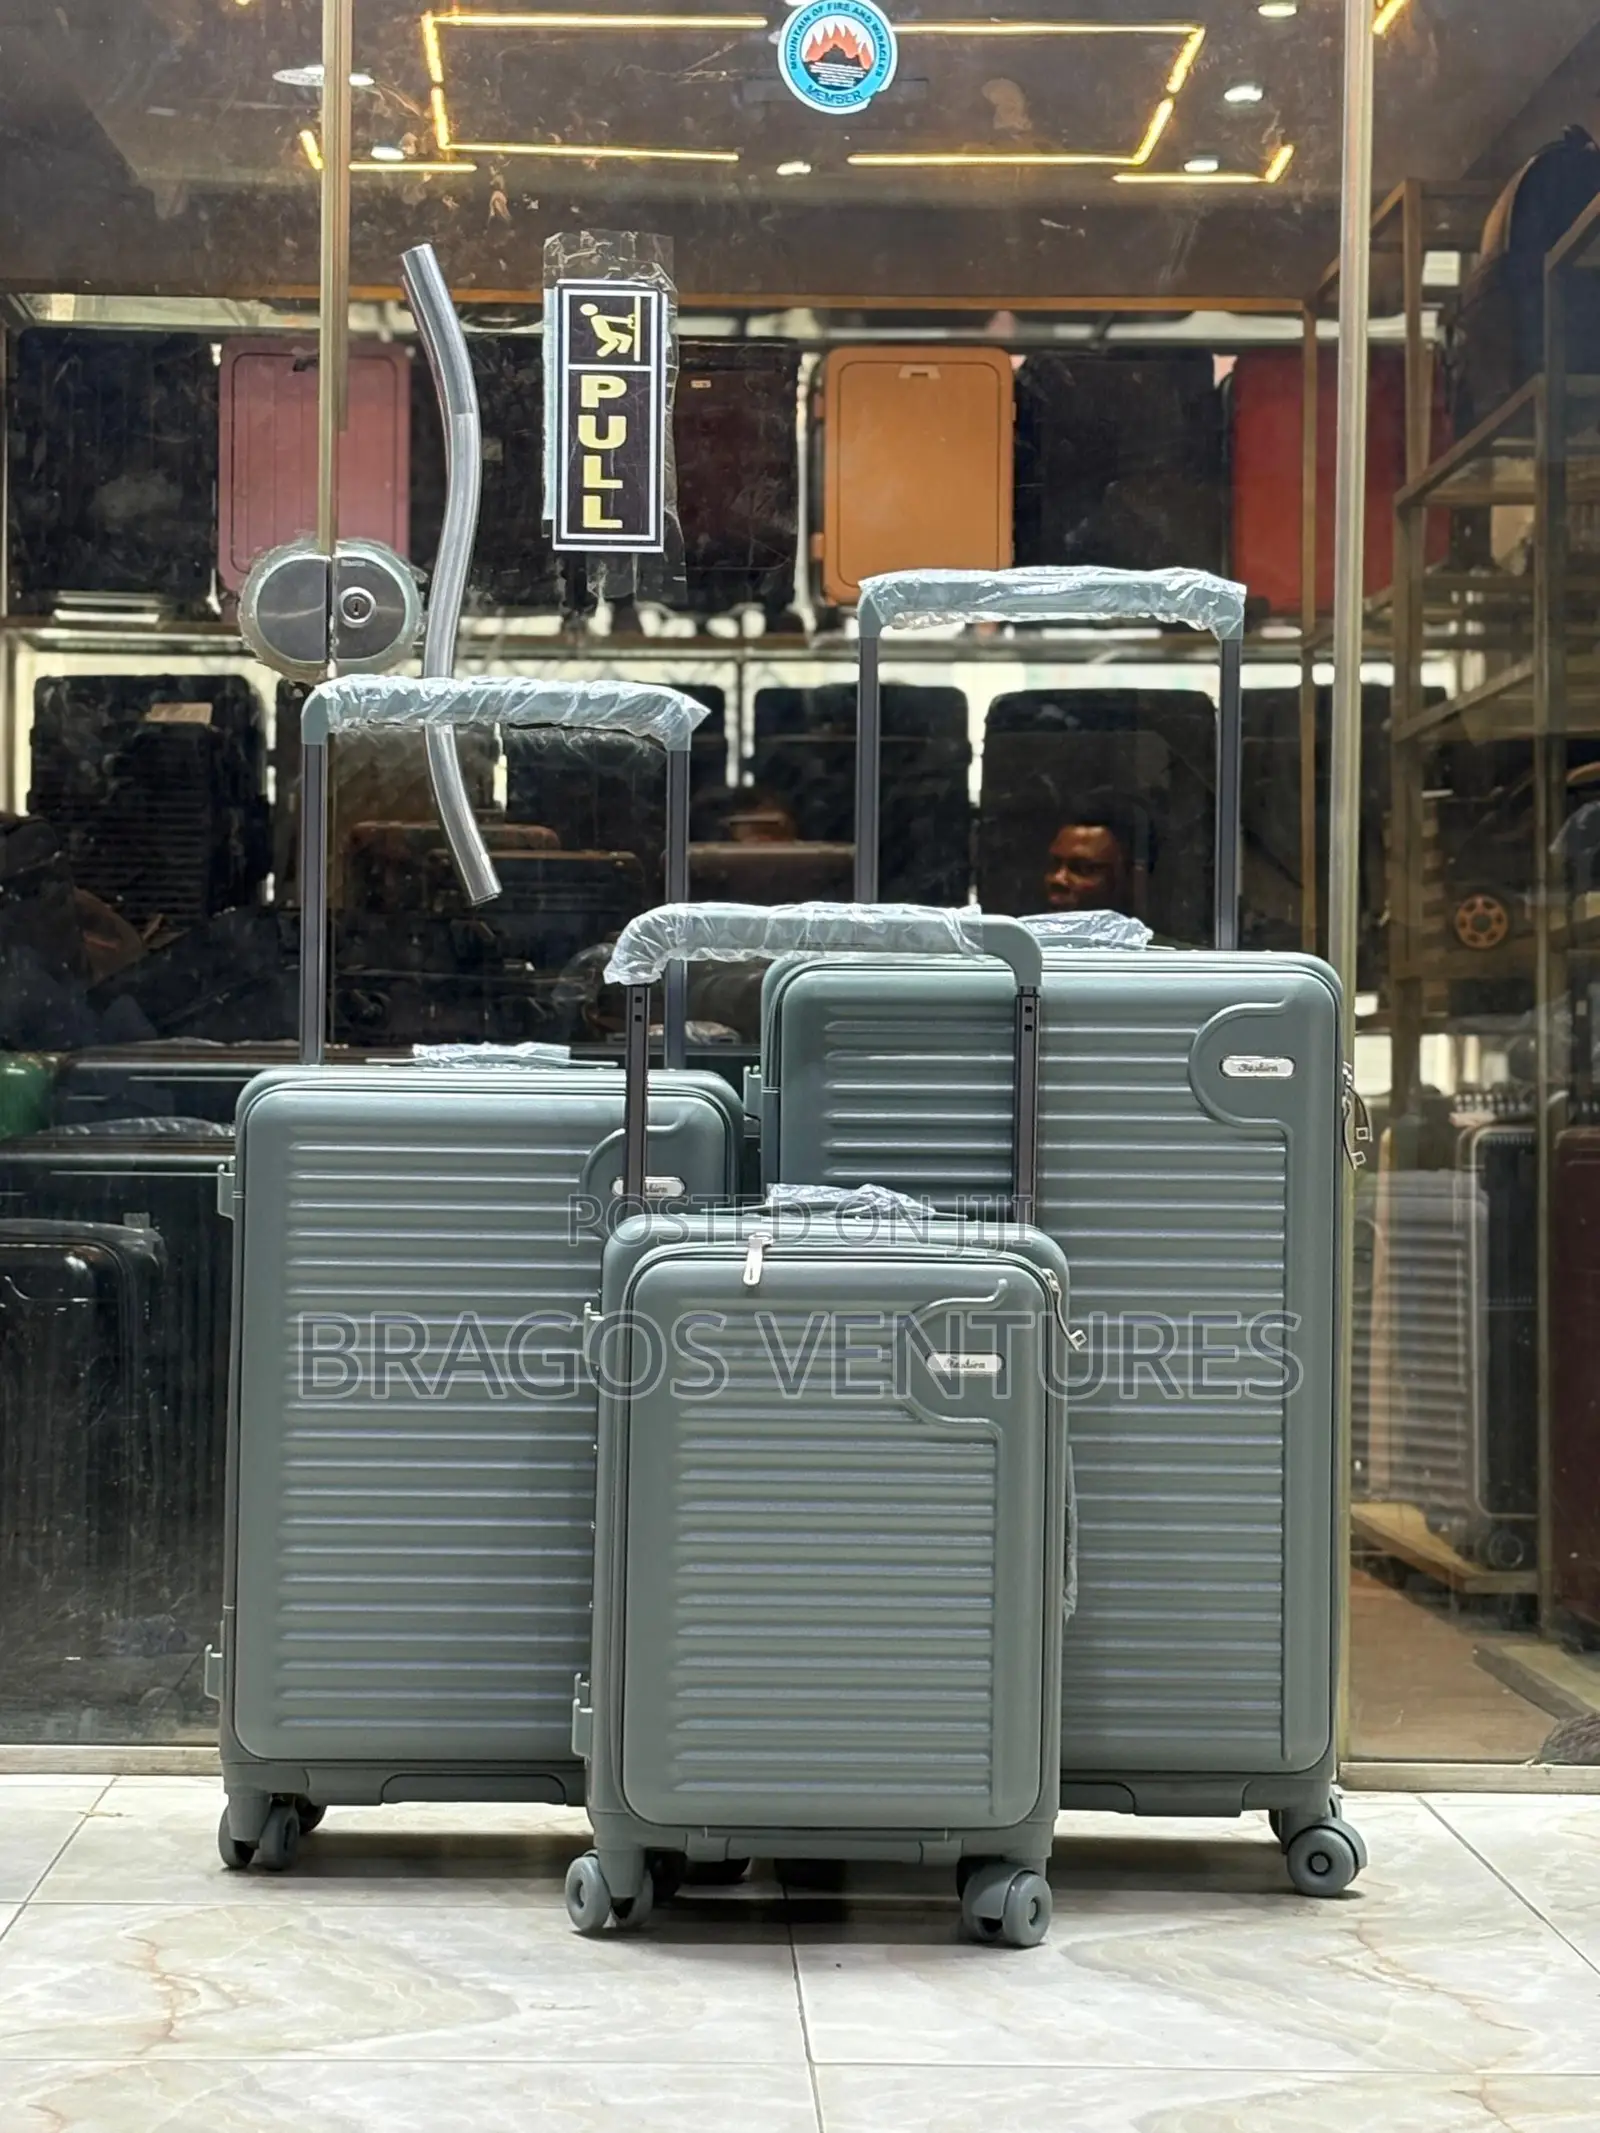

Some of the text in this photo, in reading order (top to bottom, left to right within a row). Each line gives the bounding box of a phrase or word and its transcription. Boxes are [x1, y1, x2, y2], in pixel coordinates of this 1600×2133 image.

[789, 2, 887, 77] MOUNTAIN OF FIRE AND MIRACLES
[805, 84, 863, 104] MEMBER
[577, 374, 627, 529] PULL
